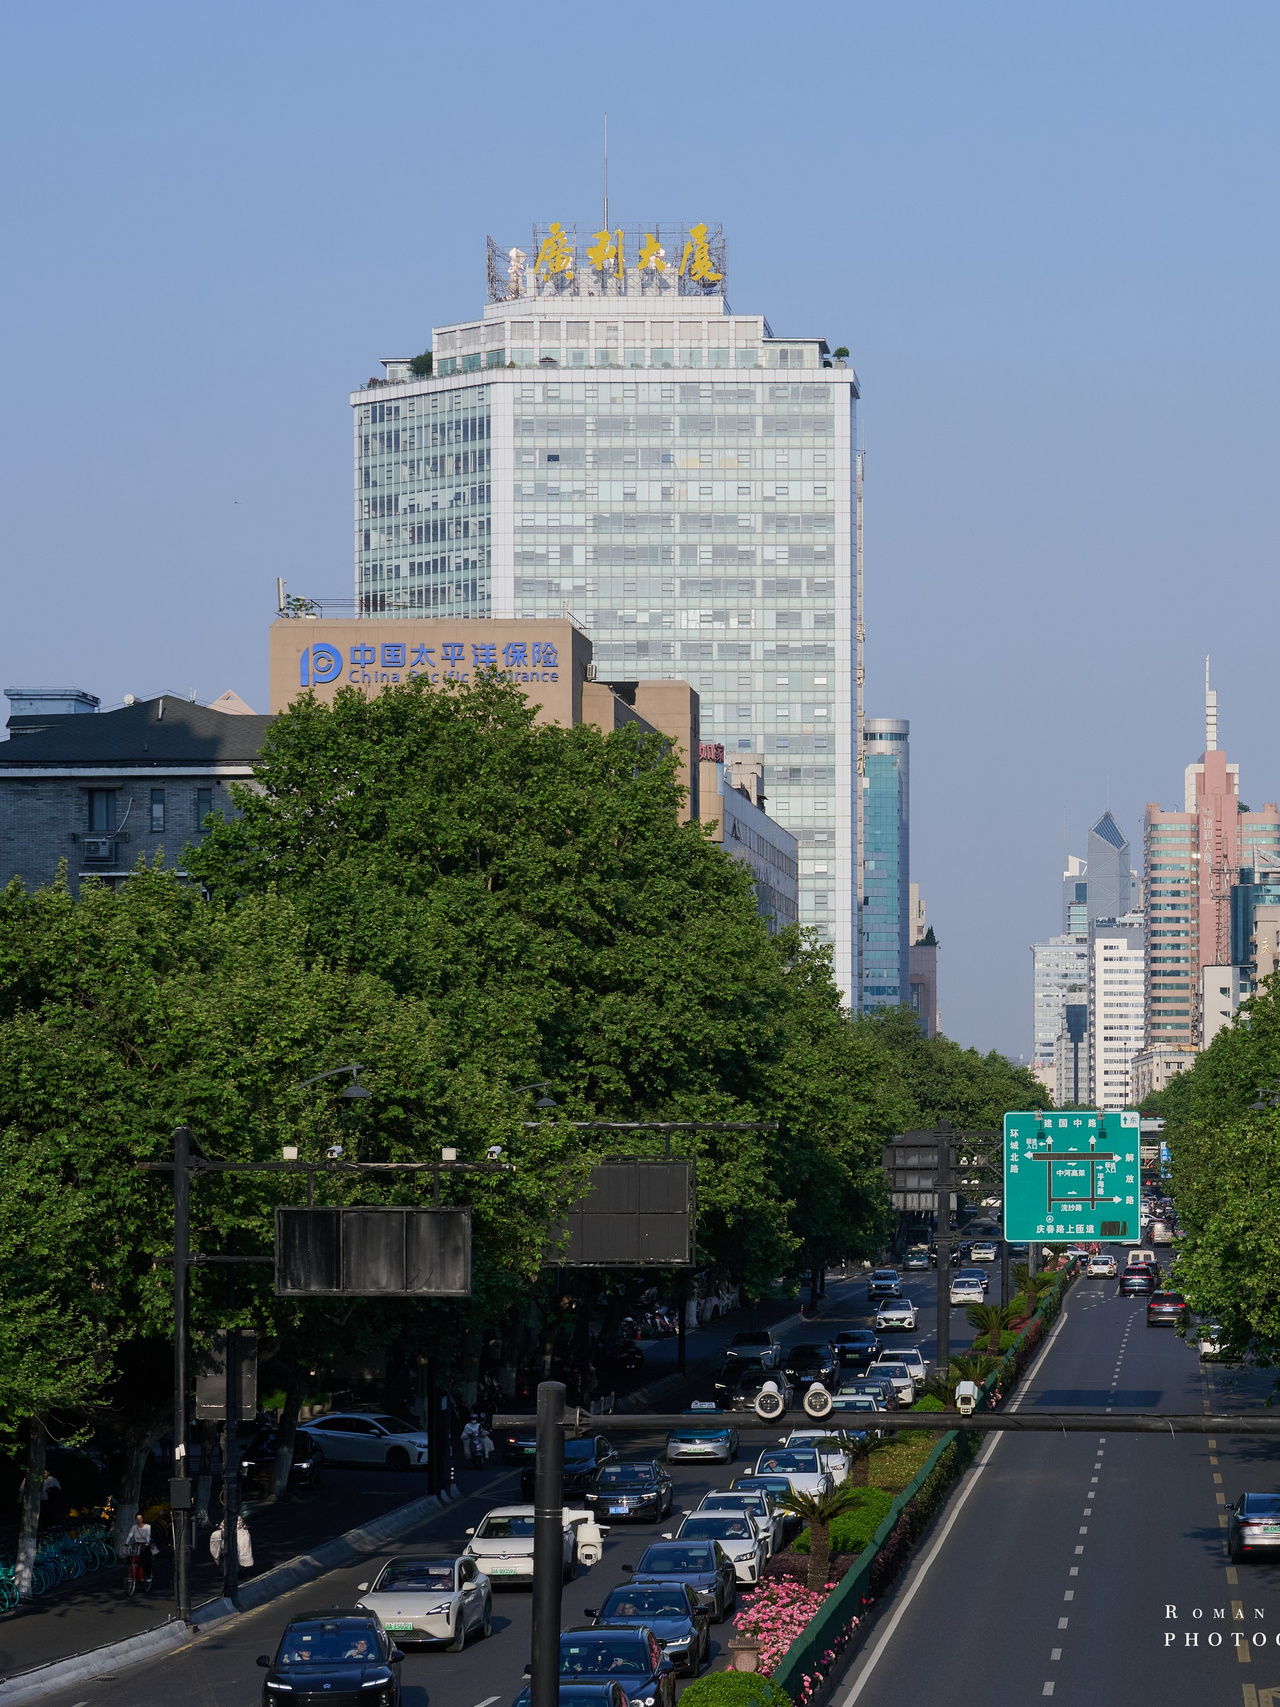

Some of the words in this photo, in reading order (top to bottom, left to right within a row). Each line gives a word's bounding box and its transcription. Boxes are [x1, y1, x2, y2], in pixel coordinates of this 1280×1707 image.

[350, 642, 559, 668] 中国太平洋保险
[349, 670, 400, 684] China
[1044, 1118, 1097, 1128] 建国中路
[1009, 1129, 1019, 1174] 环城北路
[1125, 1153, 1135, 1205] 解放路
[1036, 1224, 1095, 1234] 庆春路上匝道
